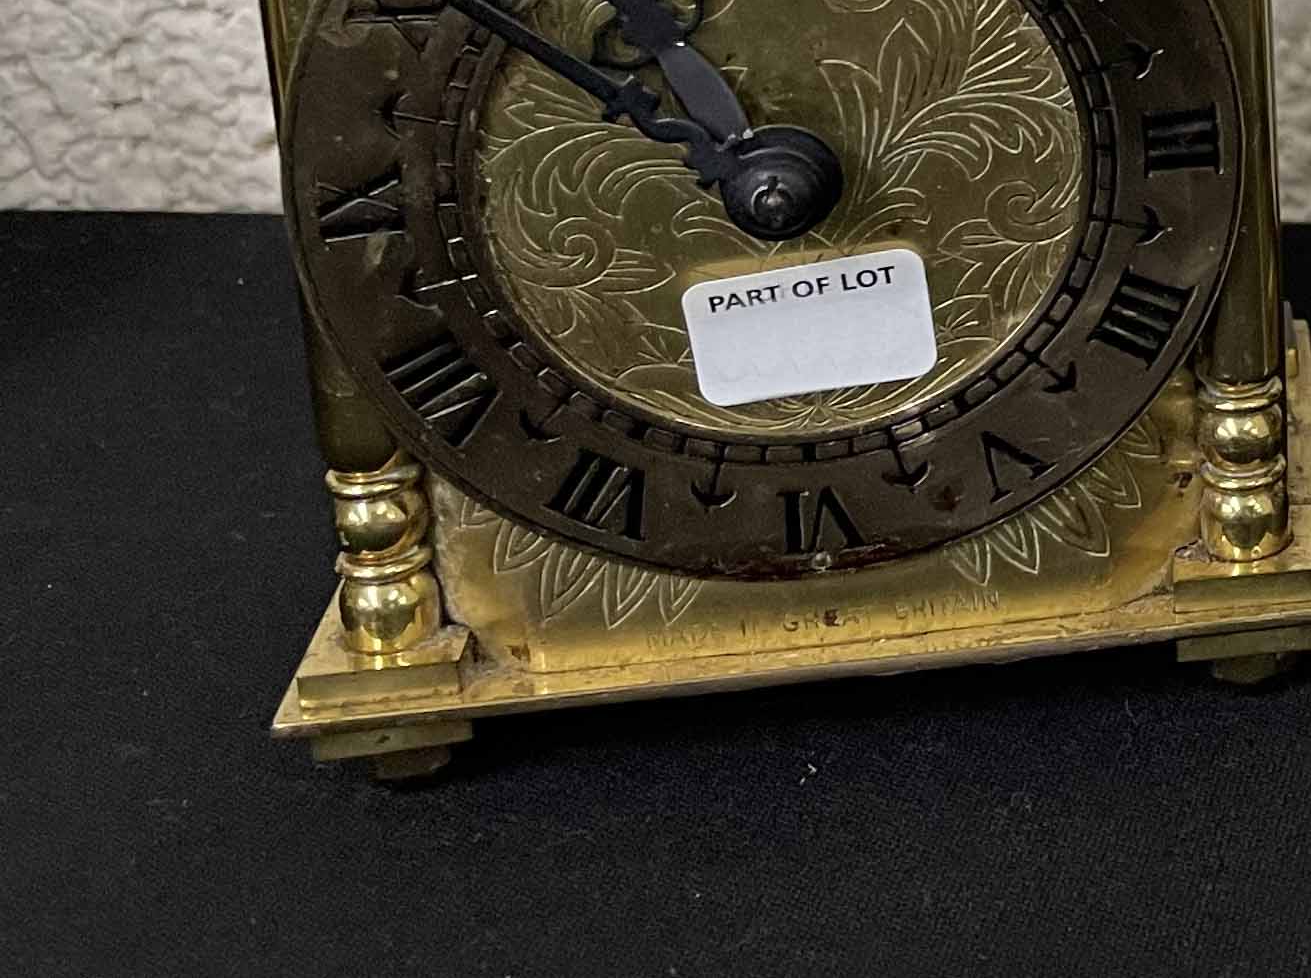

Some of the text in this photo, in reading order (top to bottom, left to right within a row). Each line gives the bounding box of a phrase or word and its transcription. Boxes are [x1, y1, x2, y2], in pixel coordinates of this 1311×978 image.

[1142, 102, 1224, 179] III
[314, 162, 406, 243] IX
[708, 266, 895, 313] PART OF LOT
[1087, 266, 1198, 368] IIII
[379, 340, 503, 448] VIII
[543, 447, 646, 542] VII
[981, 431, 1057, 503] V
[777, 485, 886, 556] VI
